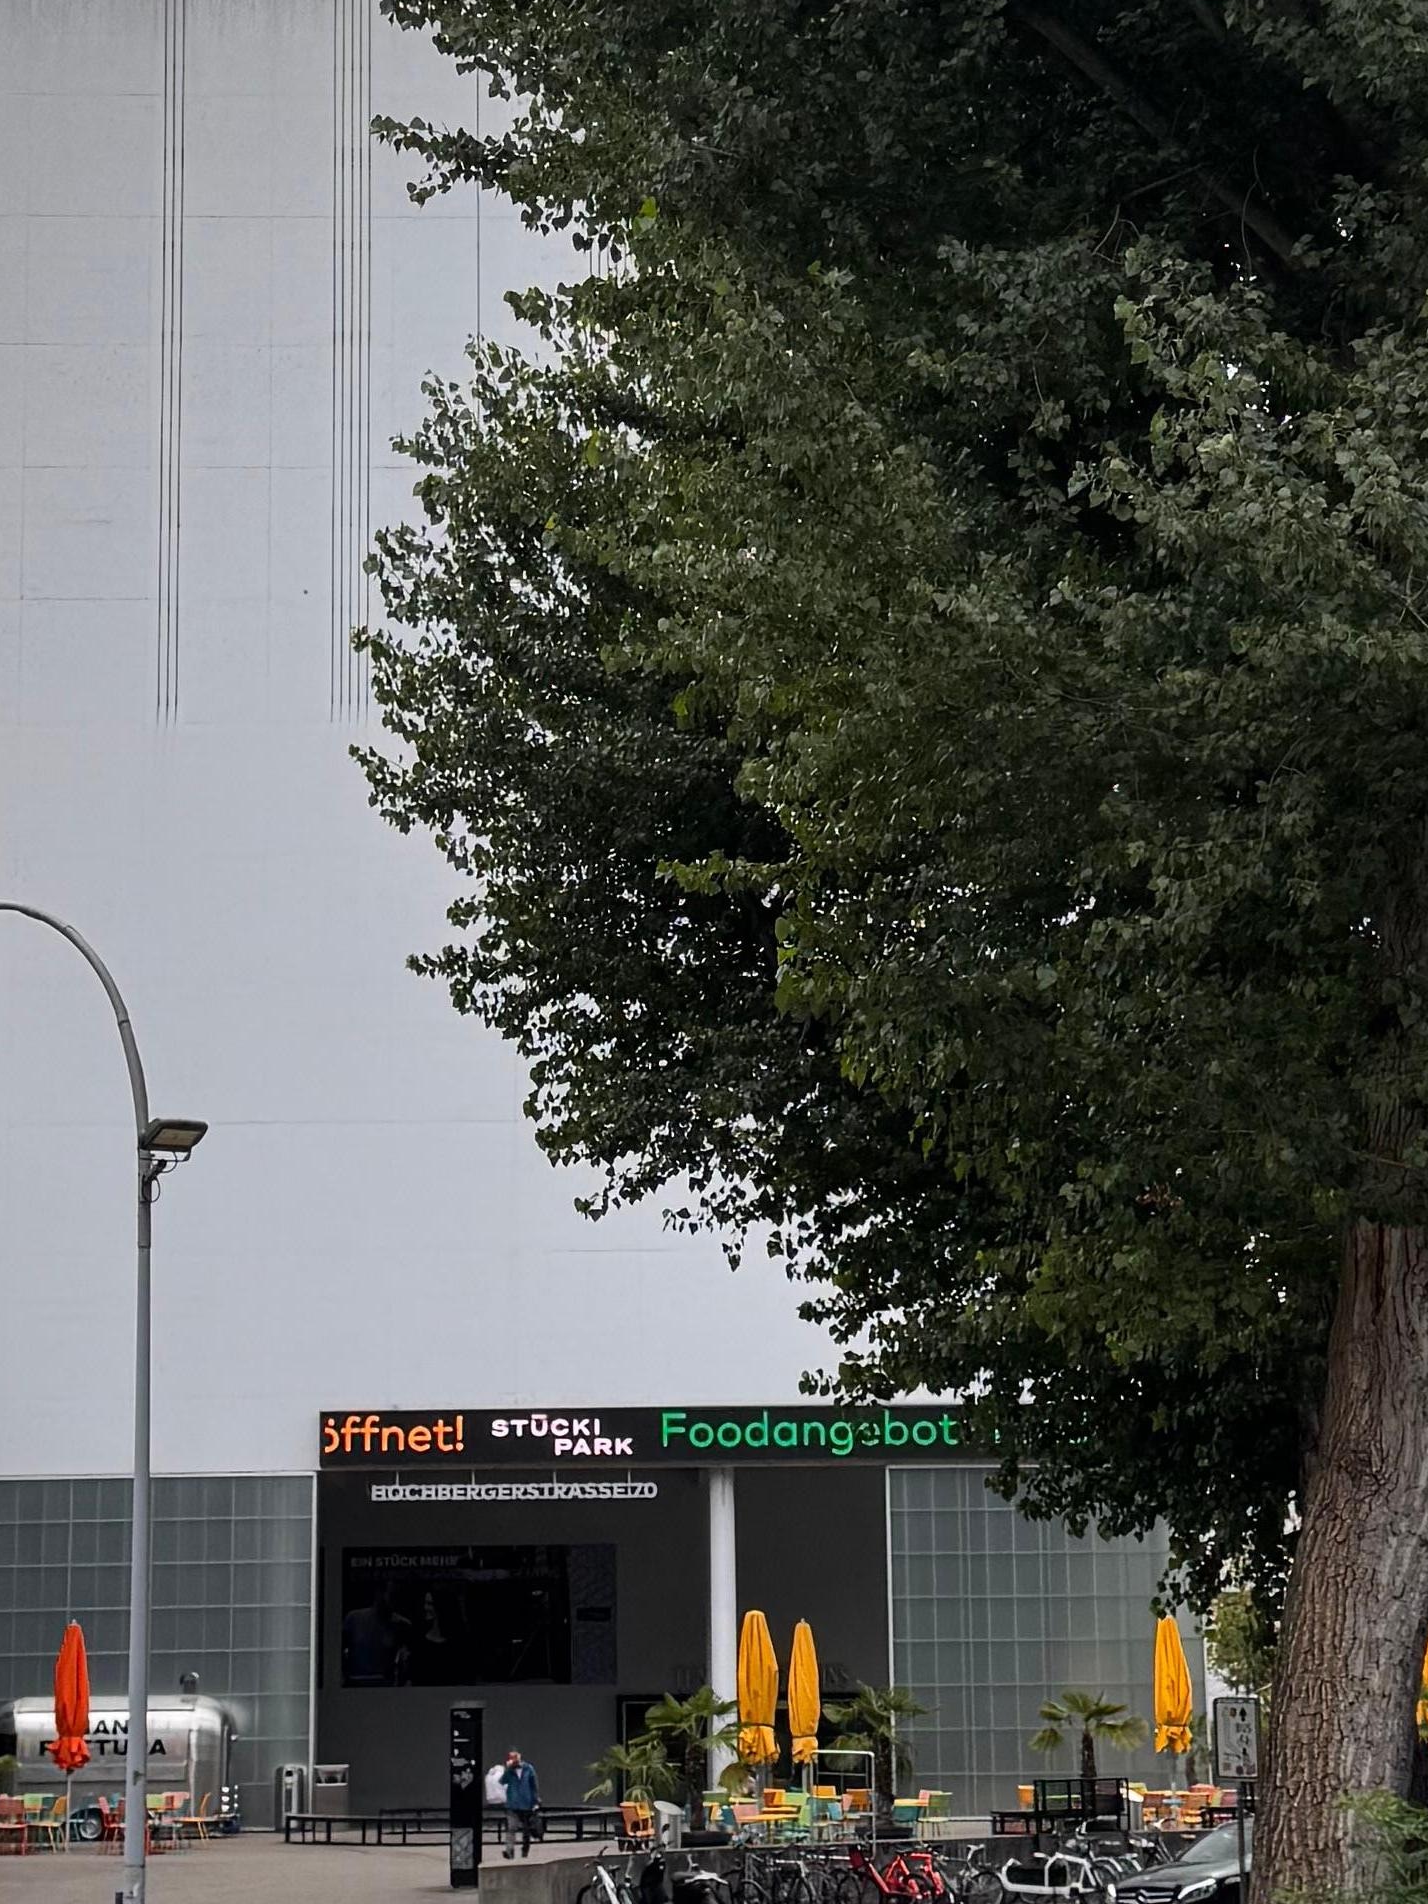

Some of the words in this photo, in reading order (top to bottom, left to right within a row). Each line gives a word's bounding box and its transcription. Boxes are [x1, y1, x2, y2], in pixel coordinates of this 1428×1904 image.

[661, 1410, 960, 1456] Foodangebot
[554, 1437, 634, 1456] PARK
[371, 1483, 627, 1501] HOCHBERGERSTRASSE
[375, 1553, 418, 1568] STÜCK
